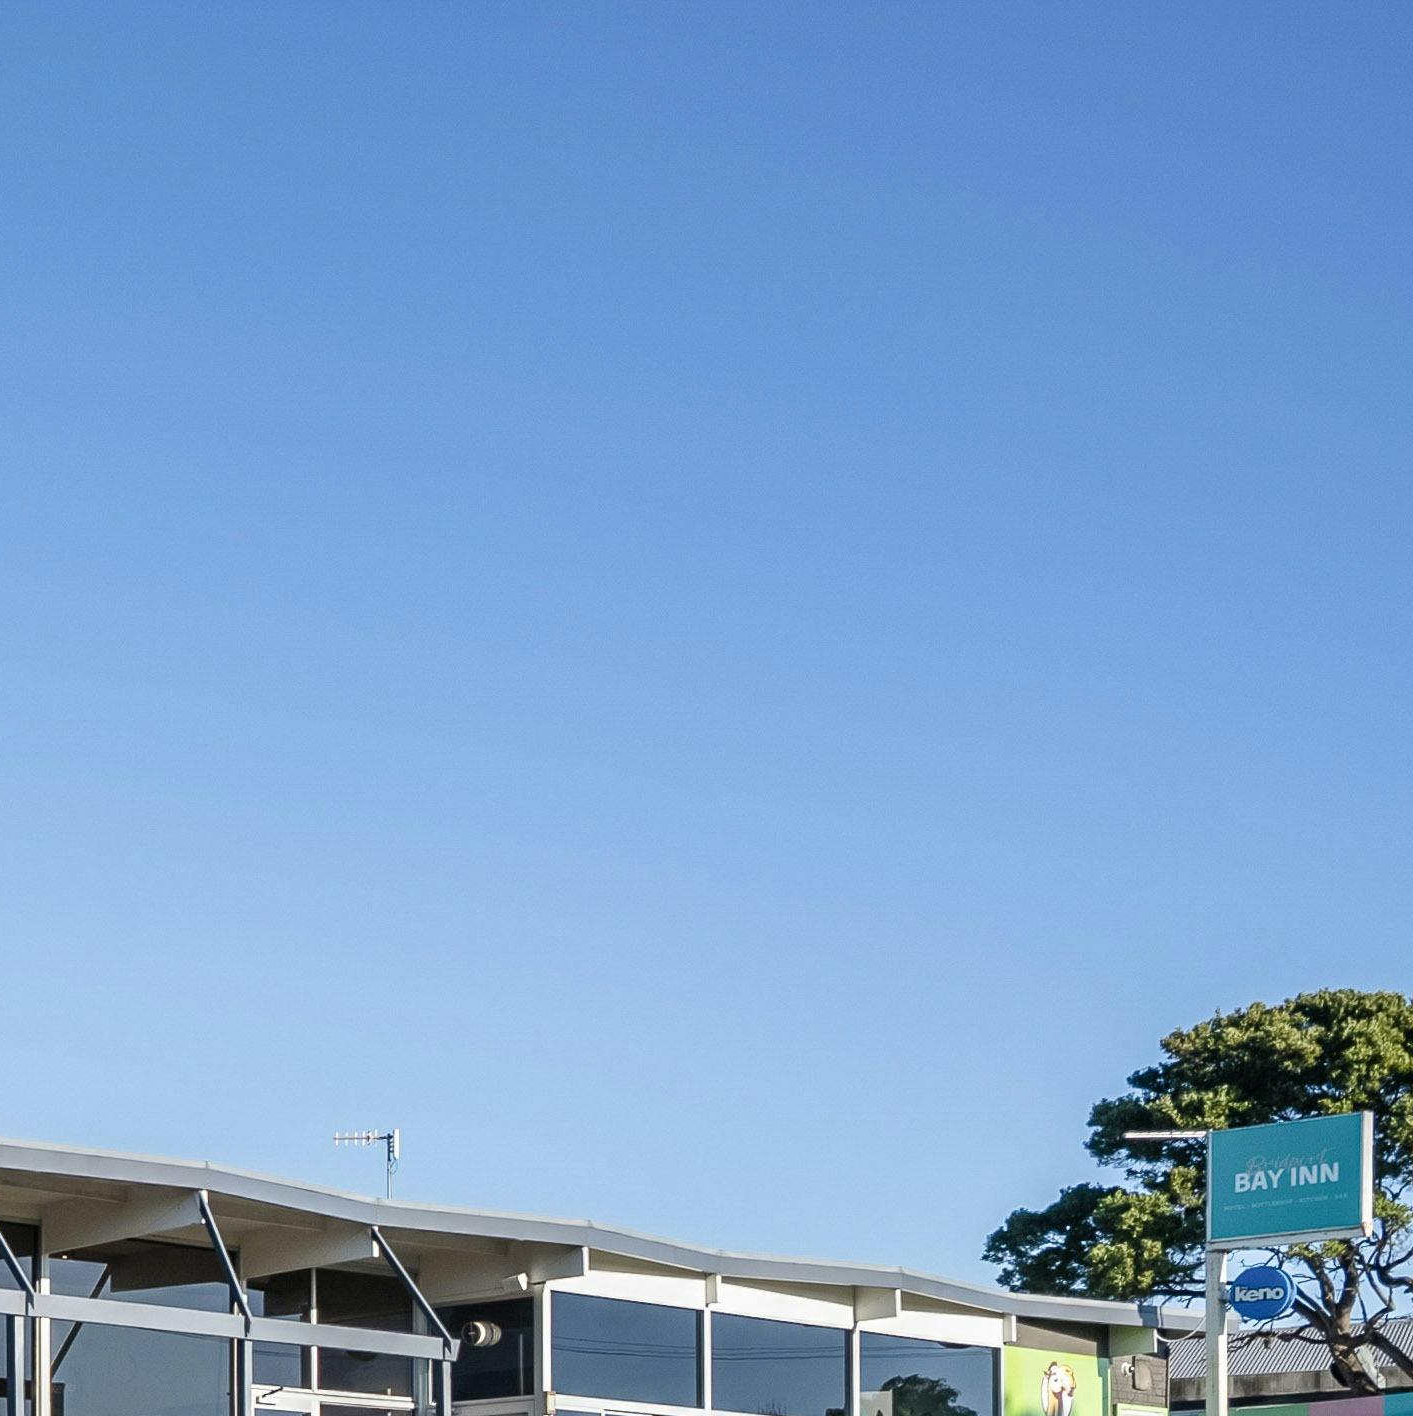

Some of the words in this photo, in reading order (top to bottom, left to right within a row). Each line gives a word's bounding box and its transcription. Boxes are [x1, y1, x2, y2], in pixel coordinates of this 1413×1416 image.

[1234, 1167, 1284, 1193] BAY
[1290, 1161, 1339, 1187] INN
[1234, 1286, 1285, 1302] keno
